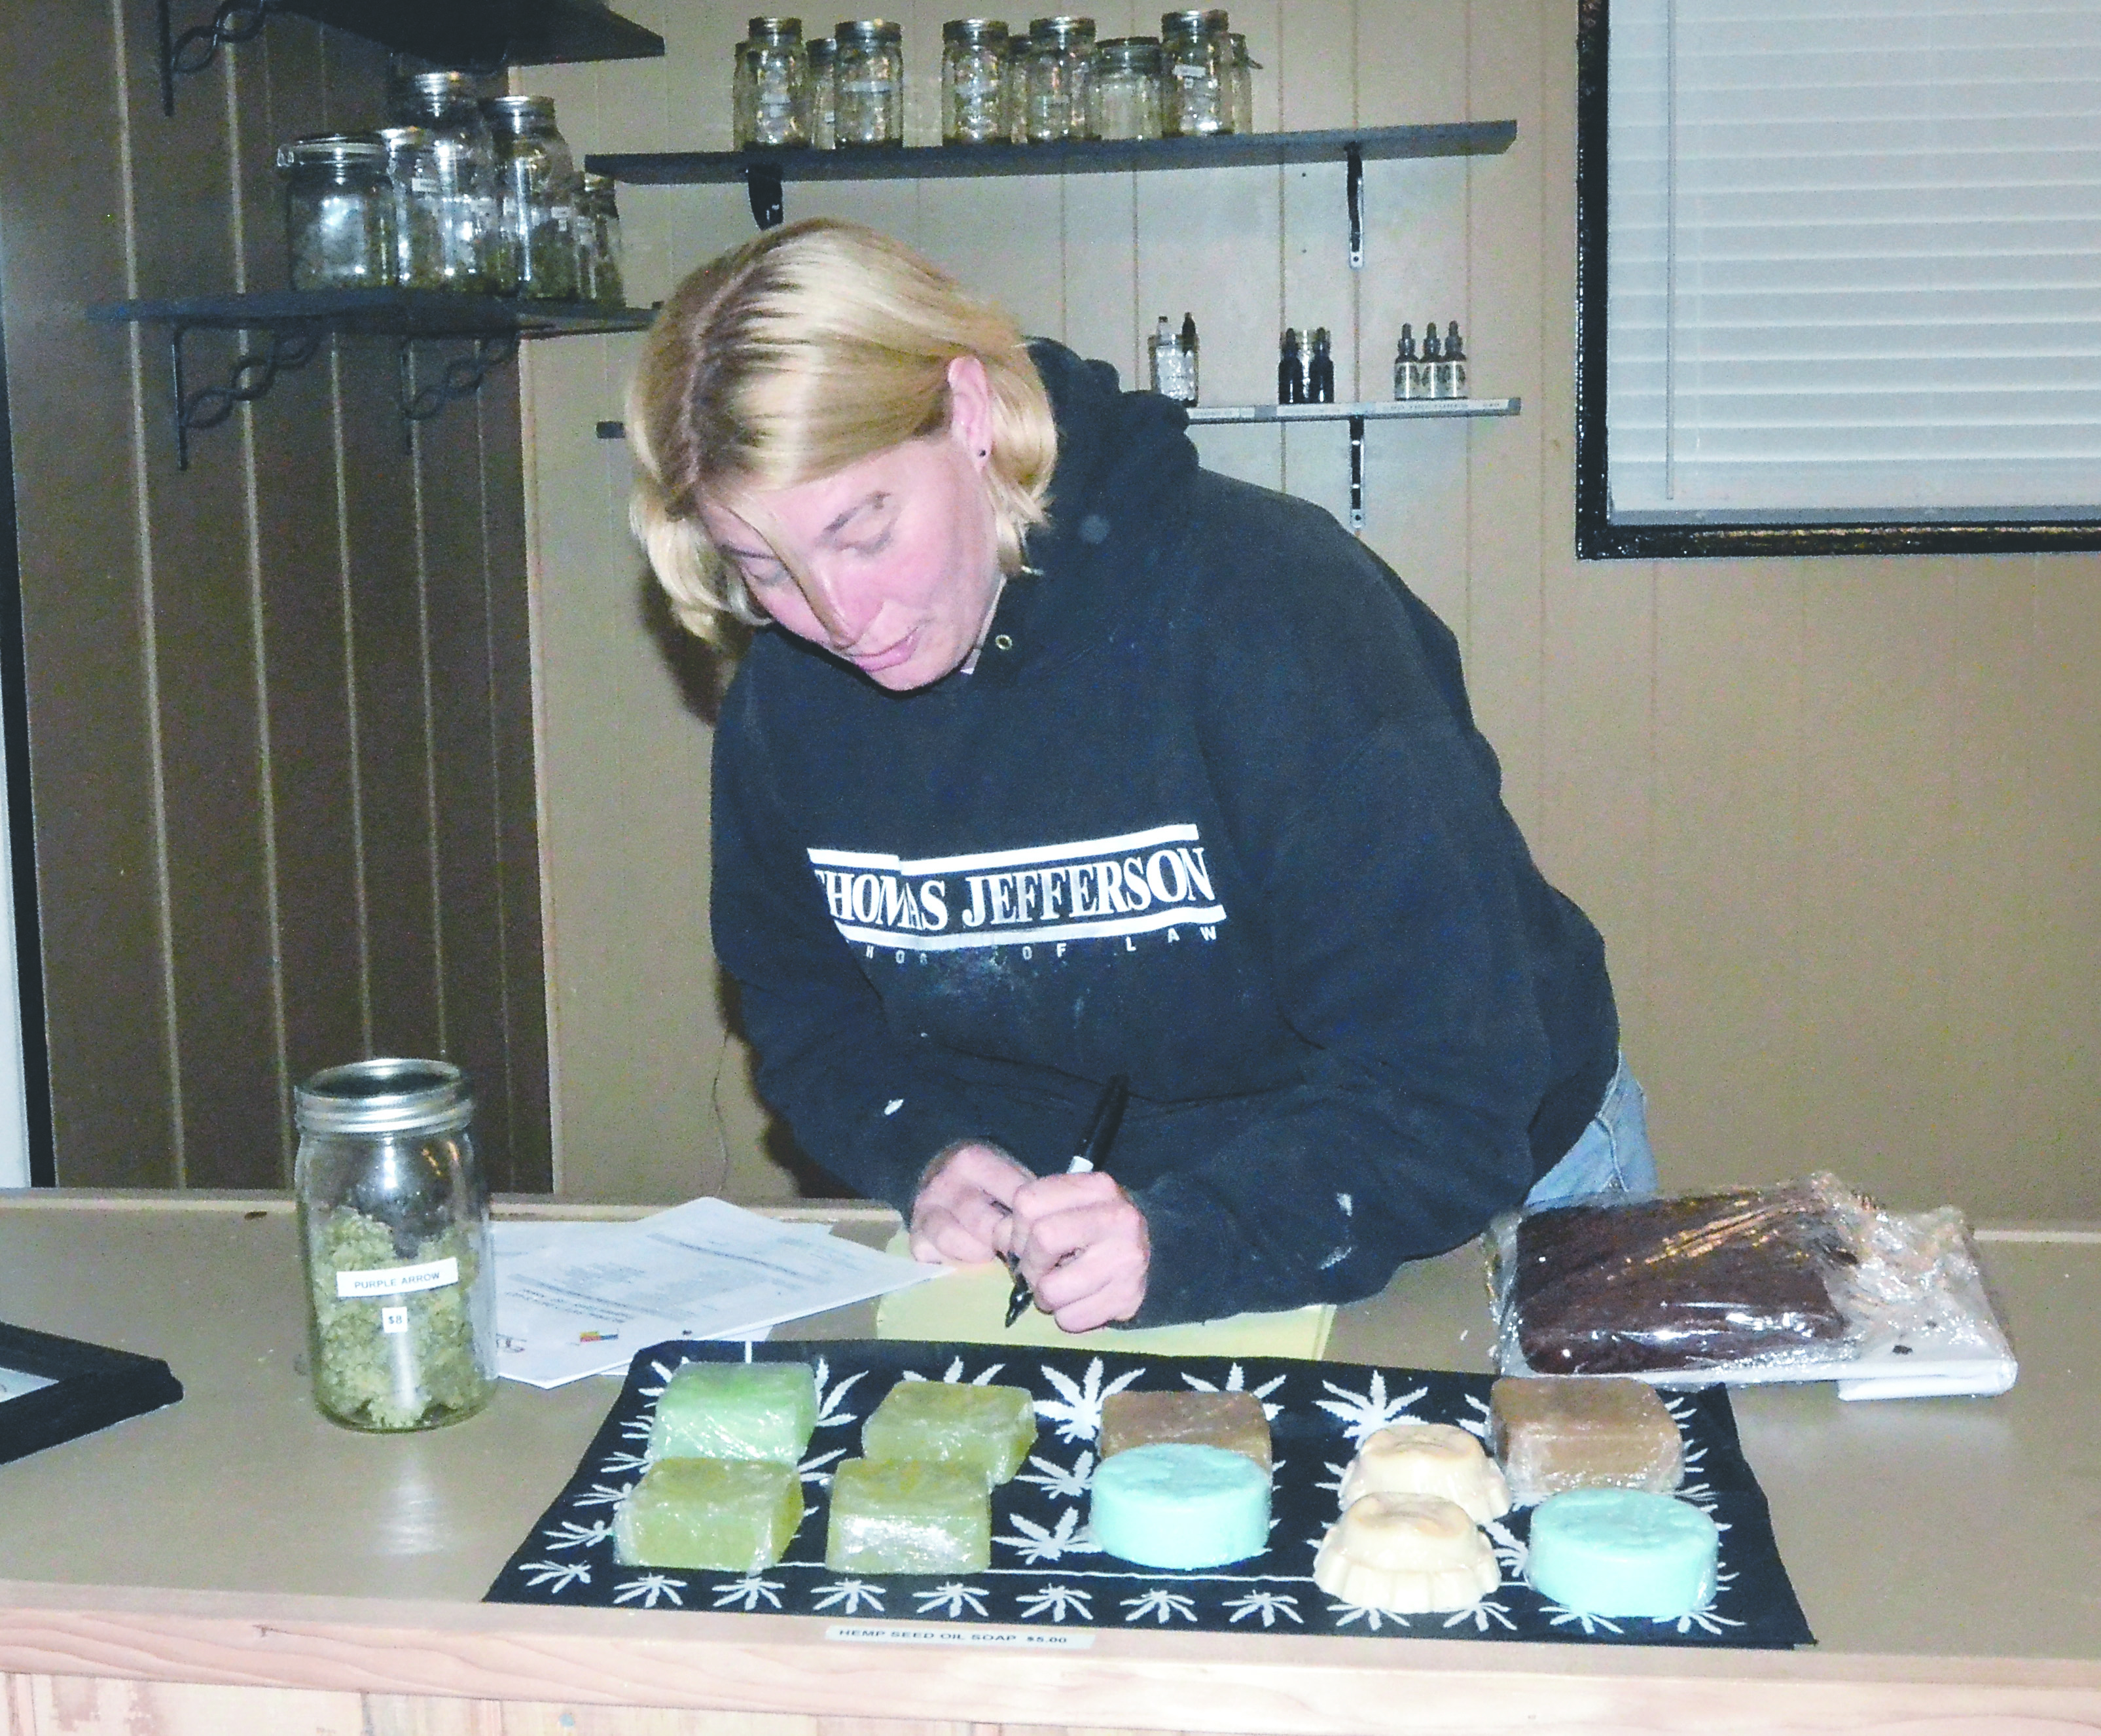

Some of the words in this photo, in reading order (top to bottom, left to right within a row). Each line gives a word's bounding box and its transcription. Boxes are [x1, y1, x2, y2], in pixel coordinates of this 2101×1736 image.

[814, 868, 948, 930] HOMAS
[961, 848, 1216, 927] JEFFERSON
[1022, 943, 1067, 961] OF
[1125, 925, 1217, 952] LAW
[354, 1279, 397, 1288] PURPLE
[401, 1272, 440, 1284] ARROW
